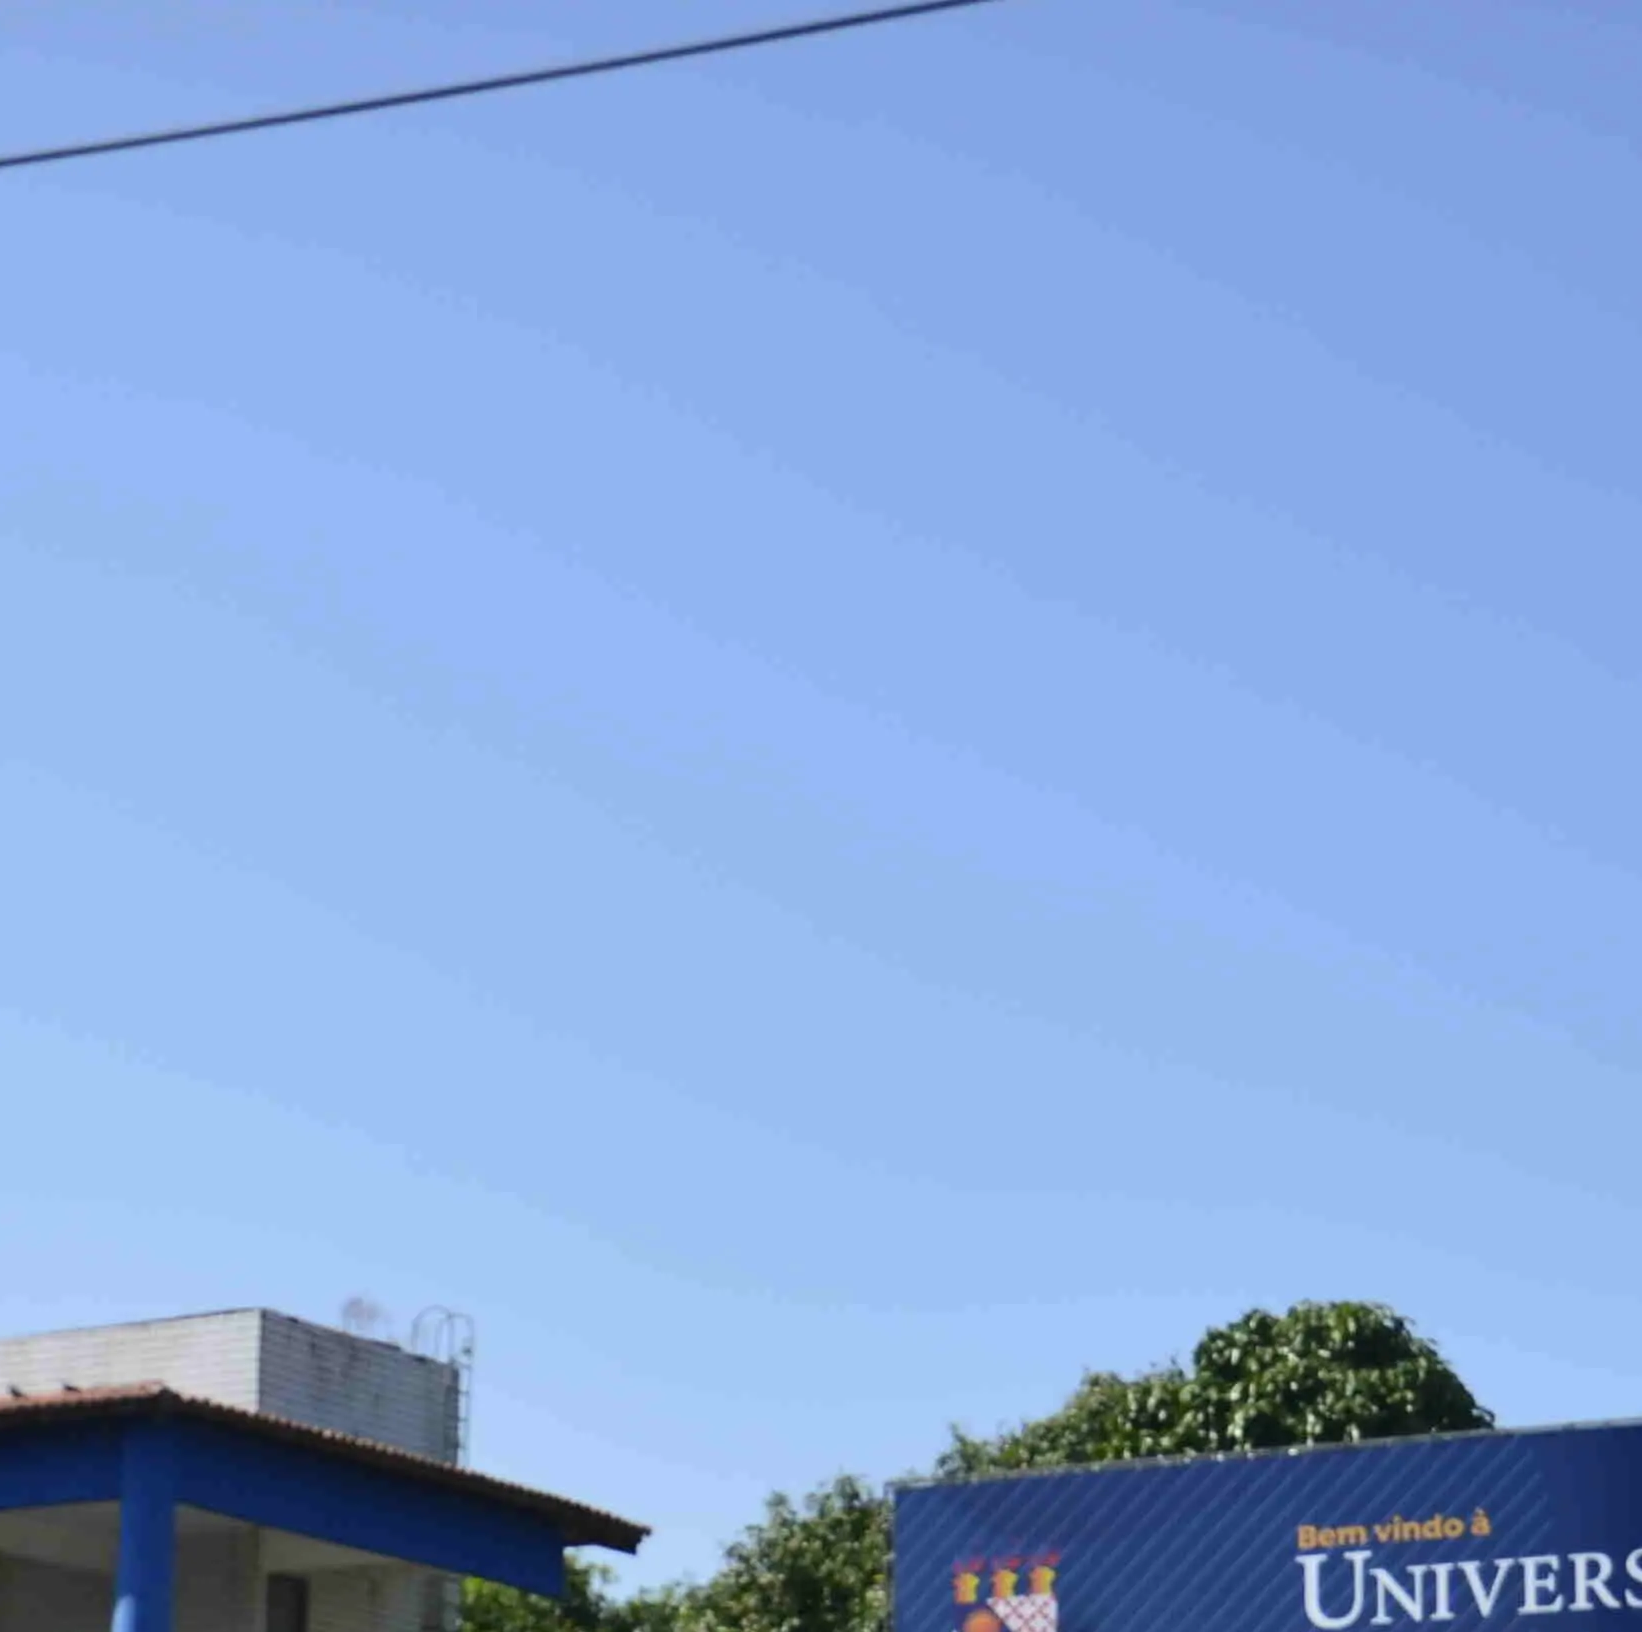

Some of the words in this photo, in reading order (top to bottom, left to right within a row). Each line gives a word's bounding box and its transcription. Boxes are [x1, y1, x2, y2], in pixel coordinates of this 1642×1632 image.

[1297, 1524, 1368, 1548] Bem
[1373, 1513, 1465, 1543] vindo
[1470, 1507, 1492, 1536] à
